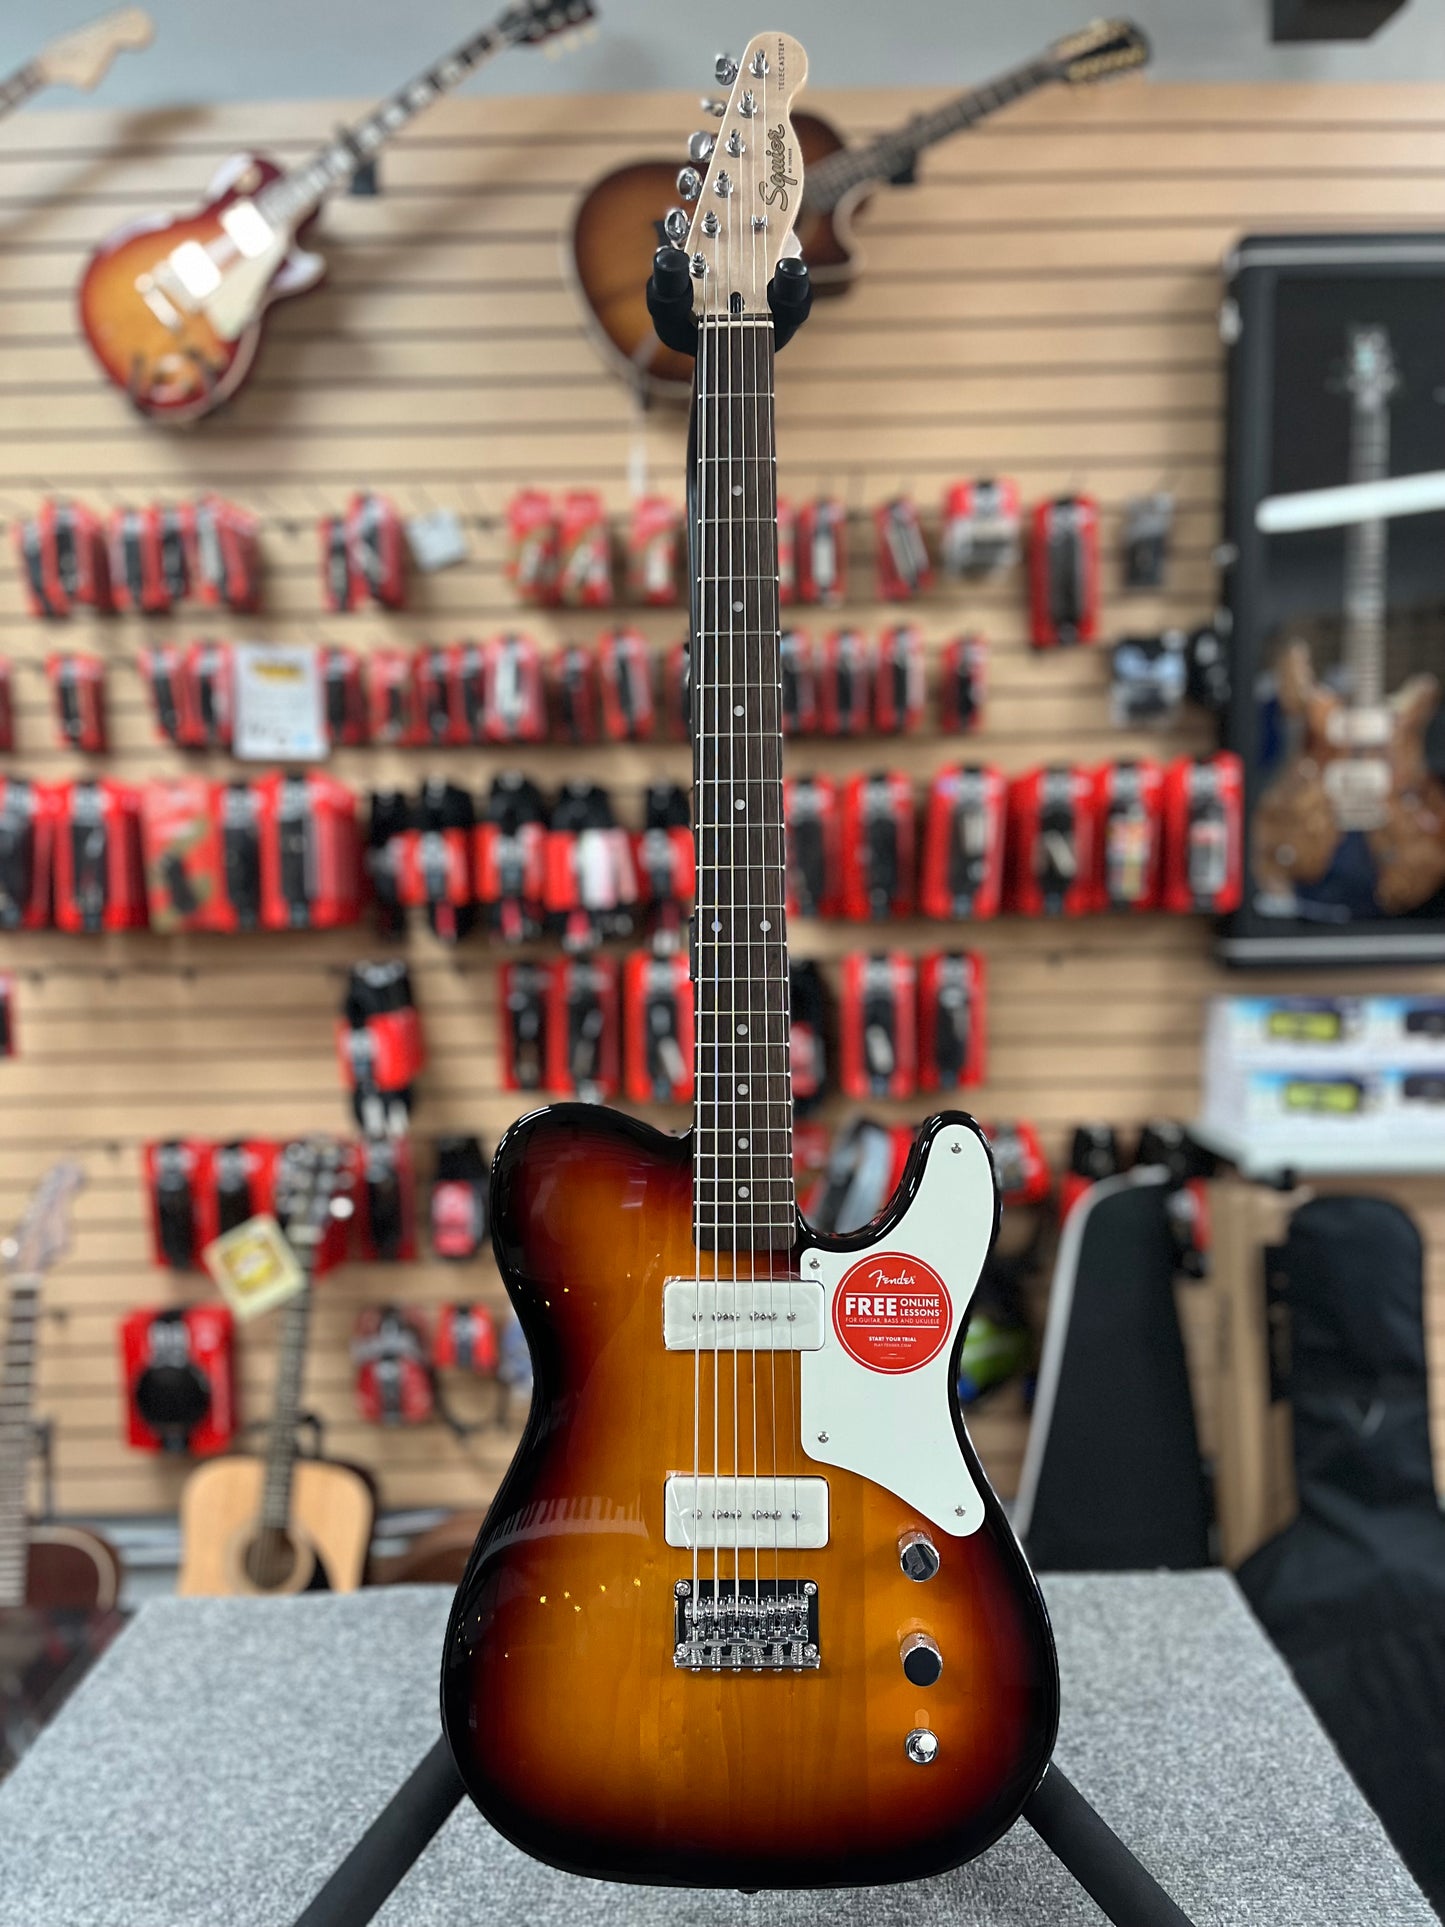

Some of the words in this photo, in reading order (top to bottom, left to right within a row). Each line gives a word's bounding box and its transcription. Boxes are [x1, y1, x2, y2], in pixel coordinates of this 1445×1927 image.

[758, 123, 798, 212] Squier
[868, 1269, 916, 1288] Fender
[845, 1297, 897, 1316] FREE
[900, 1298, 940, 1307] ONLINE
